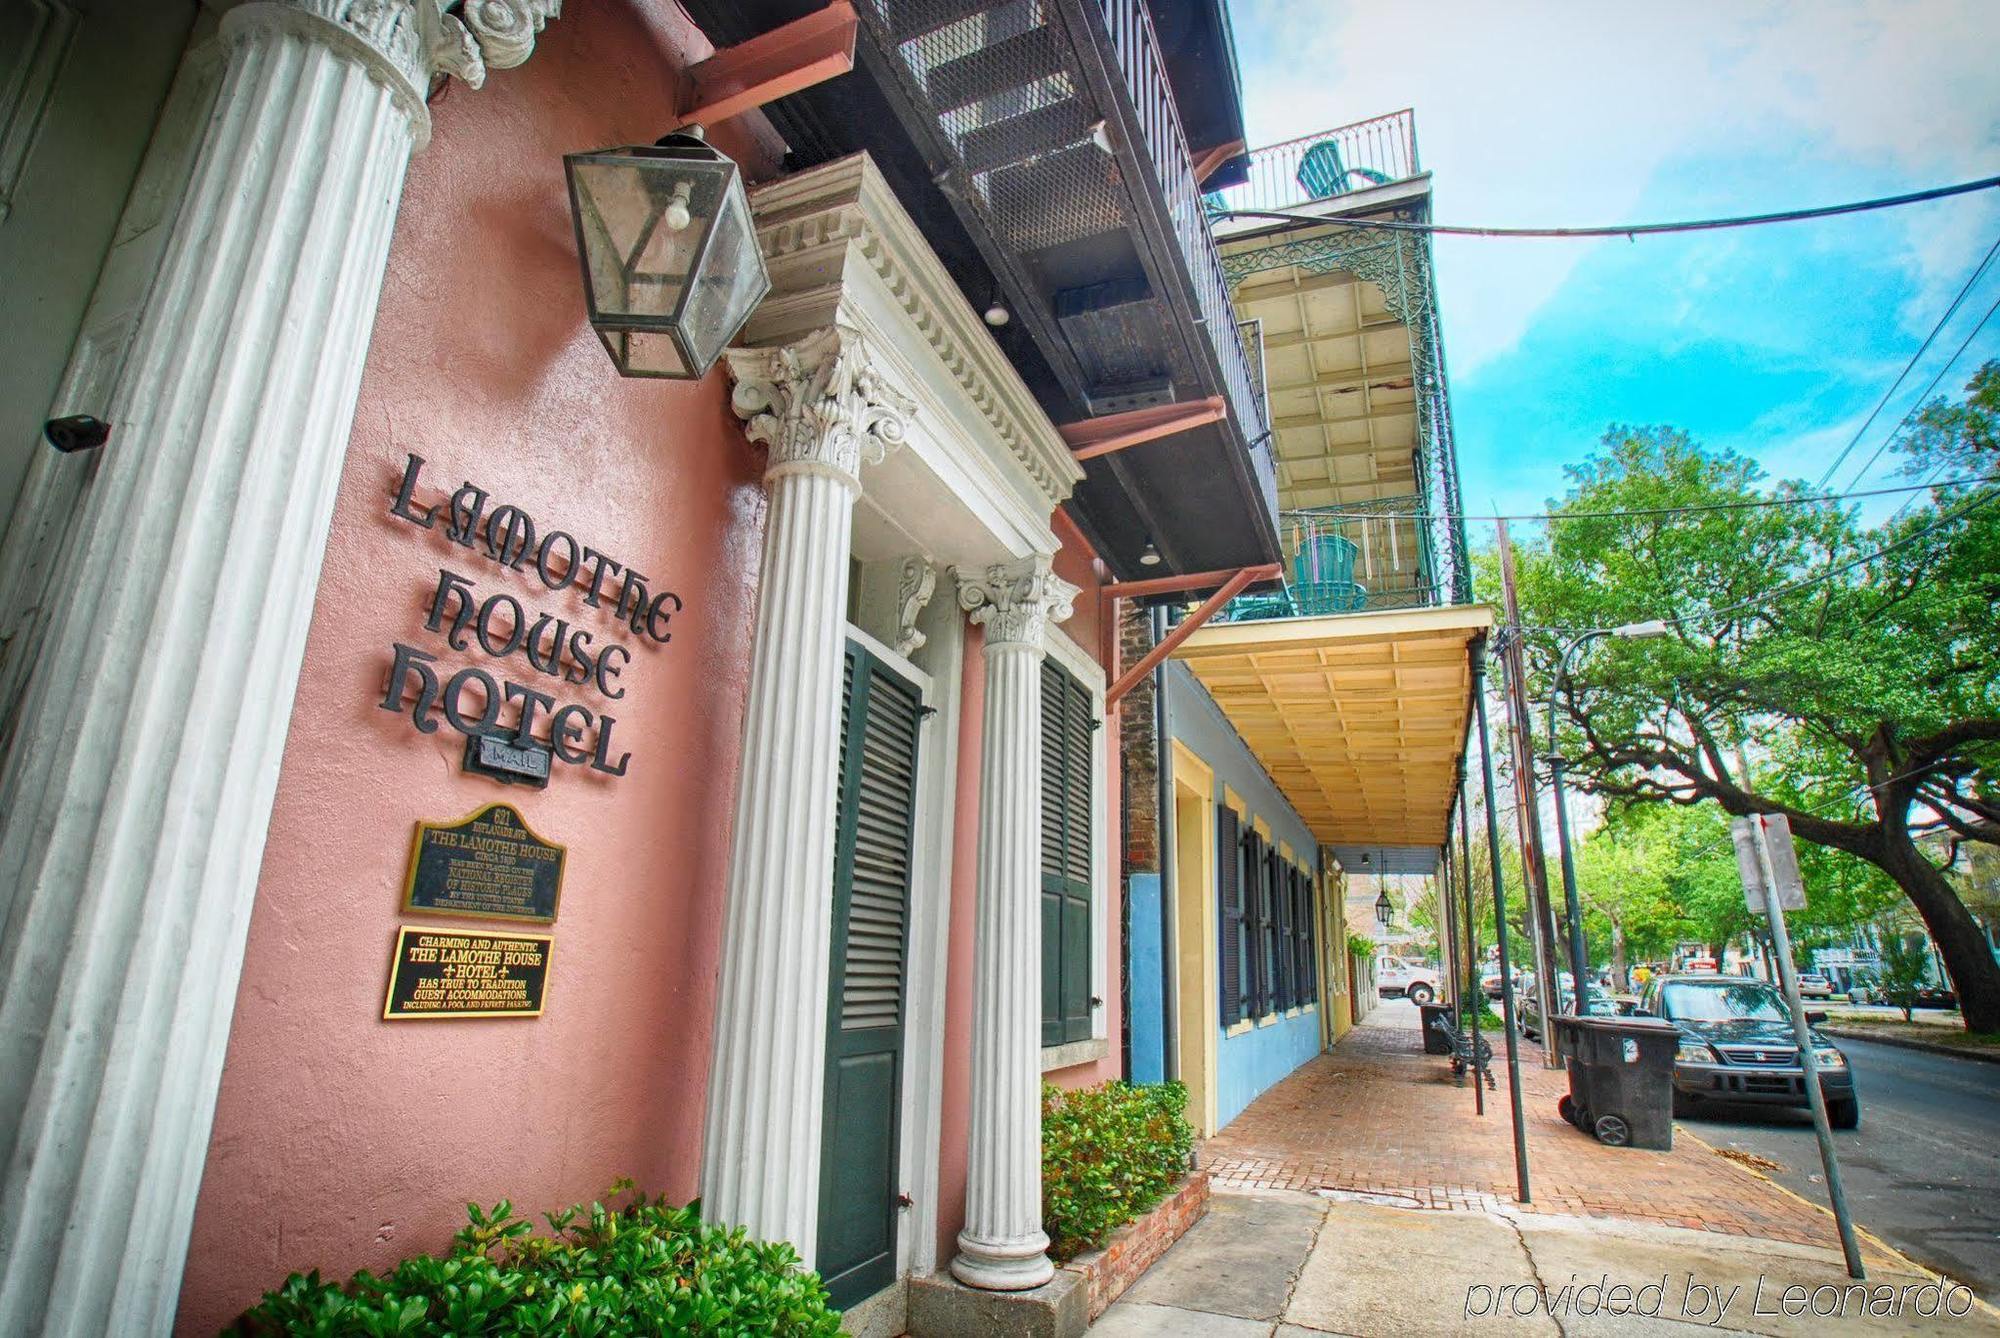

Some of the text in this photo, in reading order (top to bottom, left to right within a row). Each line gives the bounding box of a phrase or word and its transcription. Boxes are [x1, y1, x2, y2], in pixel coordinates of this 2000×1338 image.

[390, 453, 682, 643] LAMOTHE
[424, 569, 631, 699] HOUSE
[379, 643, 631, 776] HOTEL
[491, 747, 537, 769] MAIL
[494, 809, 511, 826] 621
[472, 822, 513, 838] ESPLANADE
[430, 831, 557, 861] THE LAMOTHE HOUSE
[475, 852, 498, 864] CIRCA
[448, 867, 533, 887] NATIONAL REGISTER
[446, 879, 533, 898] OF HISTORIC PLACES
[419, 936, 539, 952] CHARMING AND AUTHENTIC
[410, 948, 543, 966] THE LAMOTHE HOUSE
[456, 964, 498, 979] HOTEL
[418, 979, 527, 990] HAS TRUE TO TRADITION
[414, 989, 527, 1000] GUEST ACCOMMODATIONS
[403, 1001, 442, 1009] INCLUDING
[448, 1001, 466, 1009] POOL
